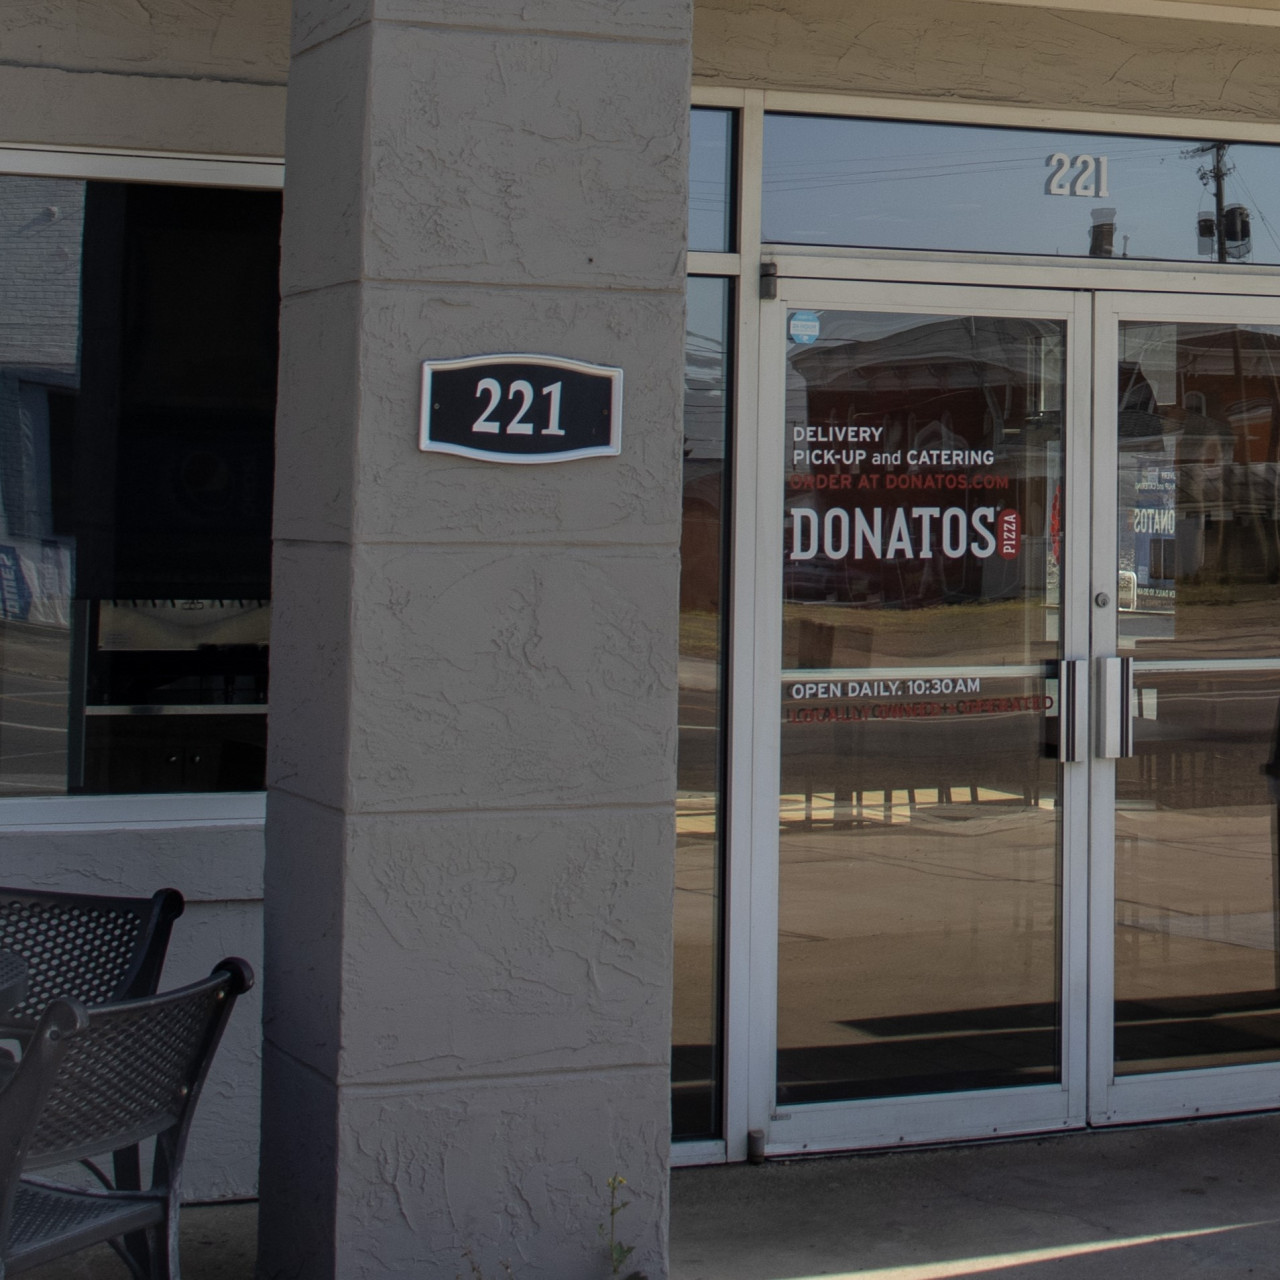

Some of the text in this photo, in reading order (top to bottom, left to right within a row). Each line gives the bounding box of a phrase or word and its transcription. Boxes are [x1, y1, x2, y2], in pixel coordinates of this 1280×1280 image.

[1050, 152, 1109, 198] 221
[471, 377, 566, 436] 221
[793, 426, 884, 442] DELIVERY
[793, 449, 995, 466] PICK-UP and CATERING
[790, 473, 1009, 490] ORDER AT DONATOS.COM
[790, 506, 997, 560] DONATOS
[1003, 514, 1016, 554] PIZZA
[792, 683, 841, 699] OPEN
[848, 680, 902, 697] DAILY.
